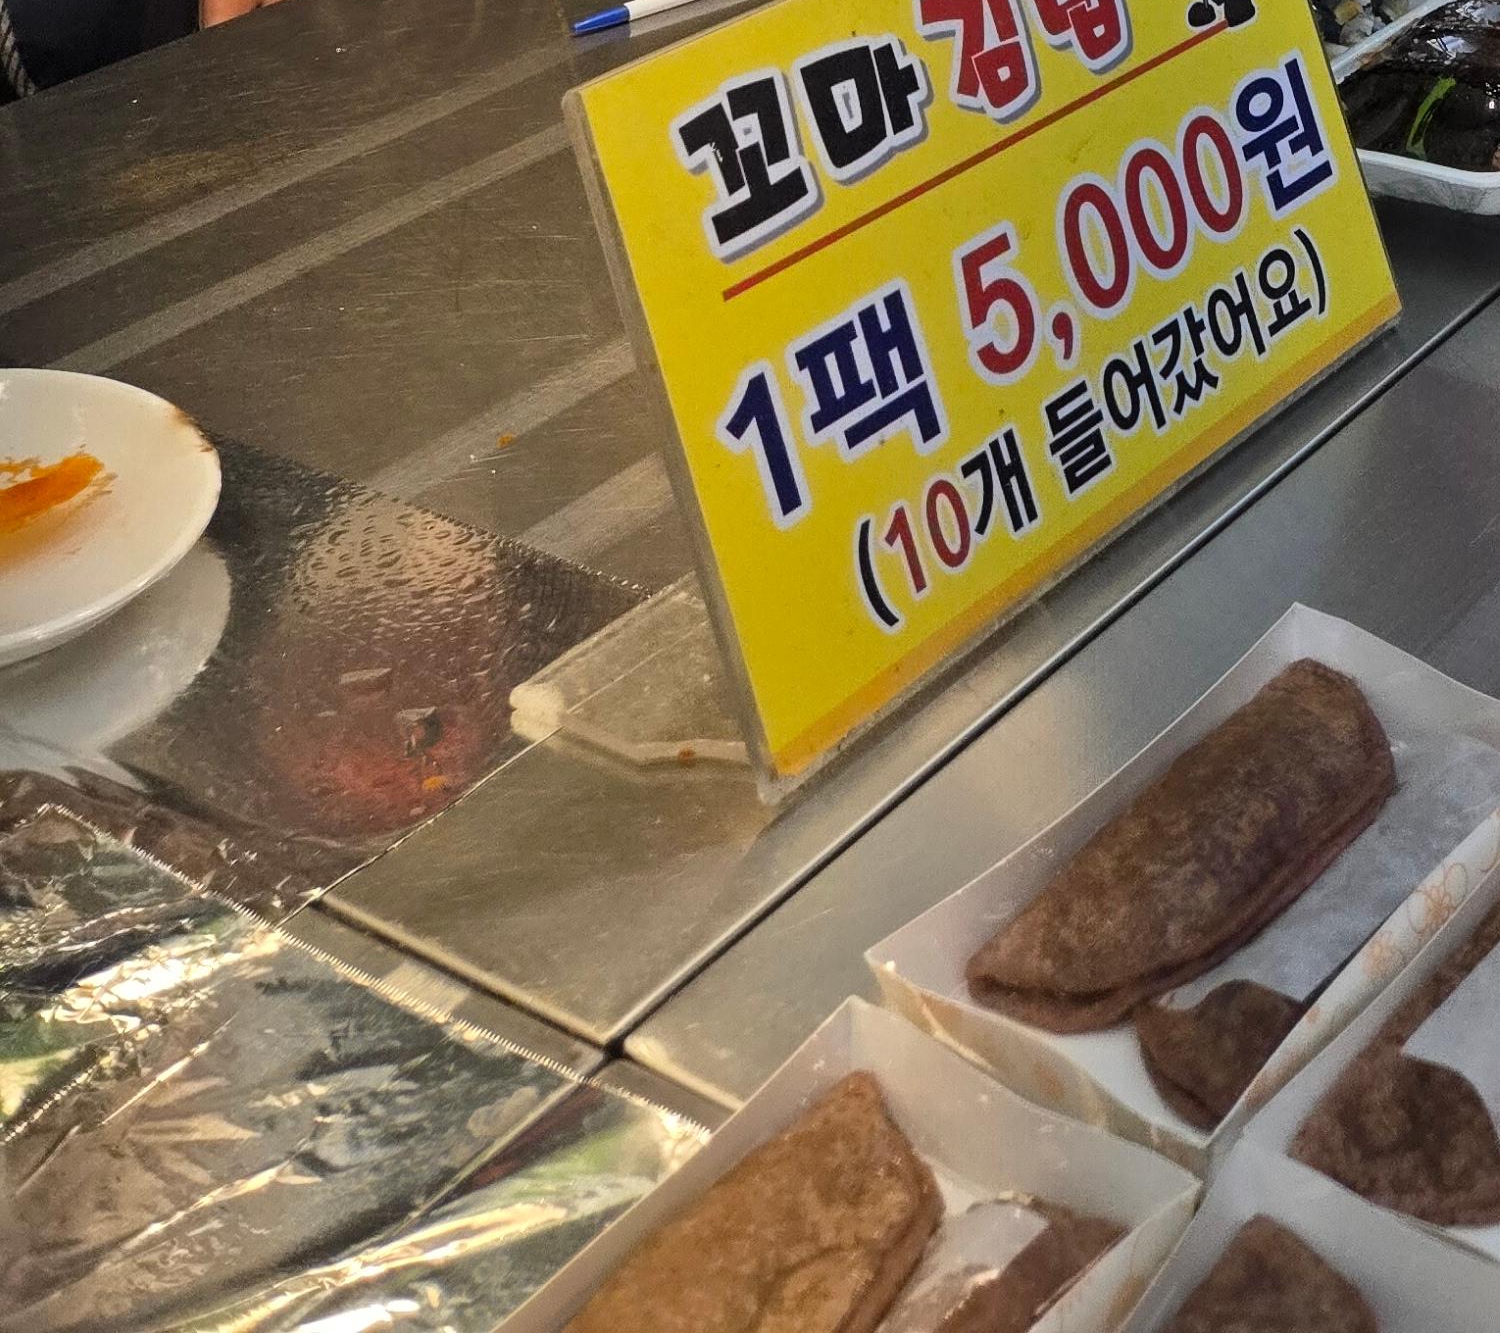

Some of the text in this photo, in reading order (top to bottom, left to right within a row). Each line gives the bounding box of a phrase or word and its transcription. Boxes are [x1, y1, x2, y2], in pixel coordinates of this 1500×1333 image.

[723, 61, 1333, 517] 1팩 5,000원
[857, 228, 1327, 629] (10개 들어갔어요)
